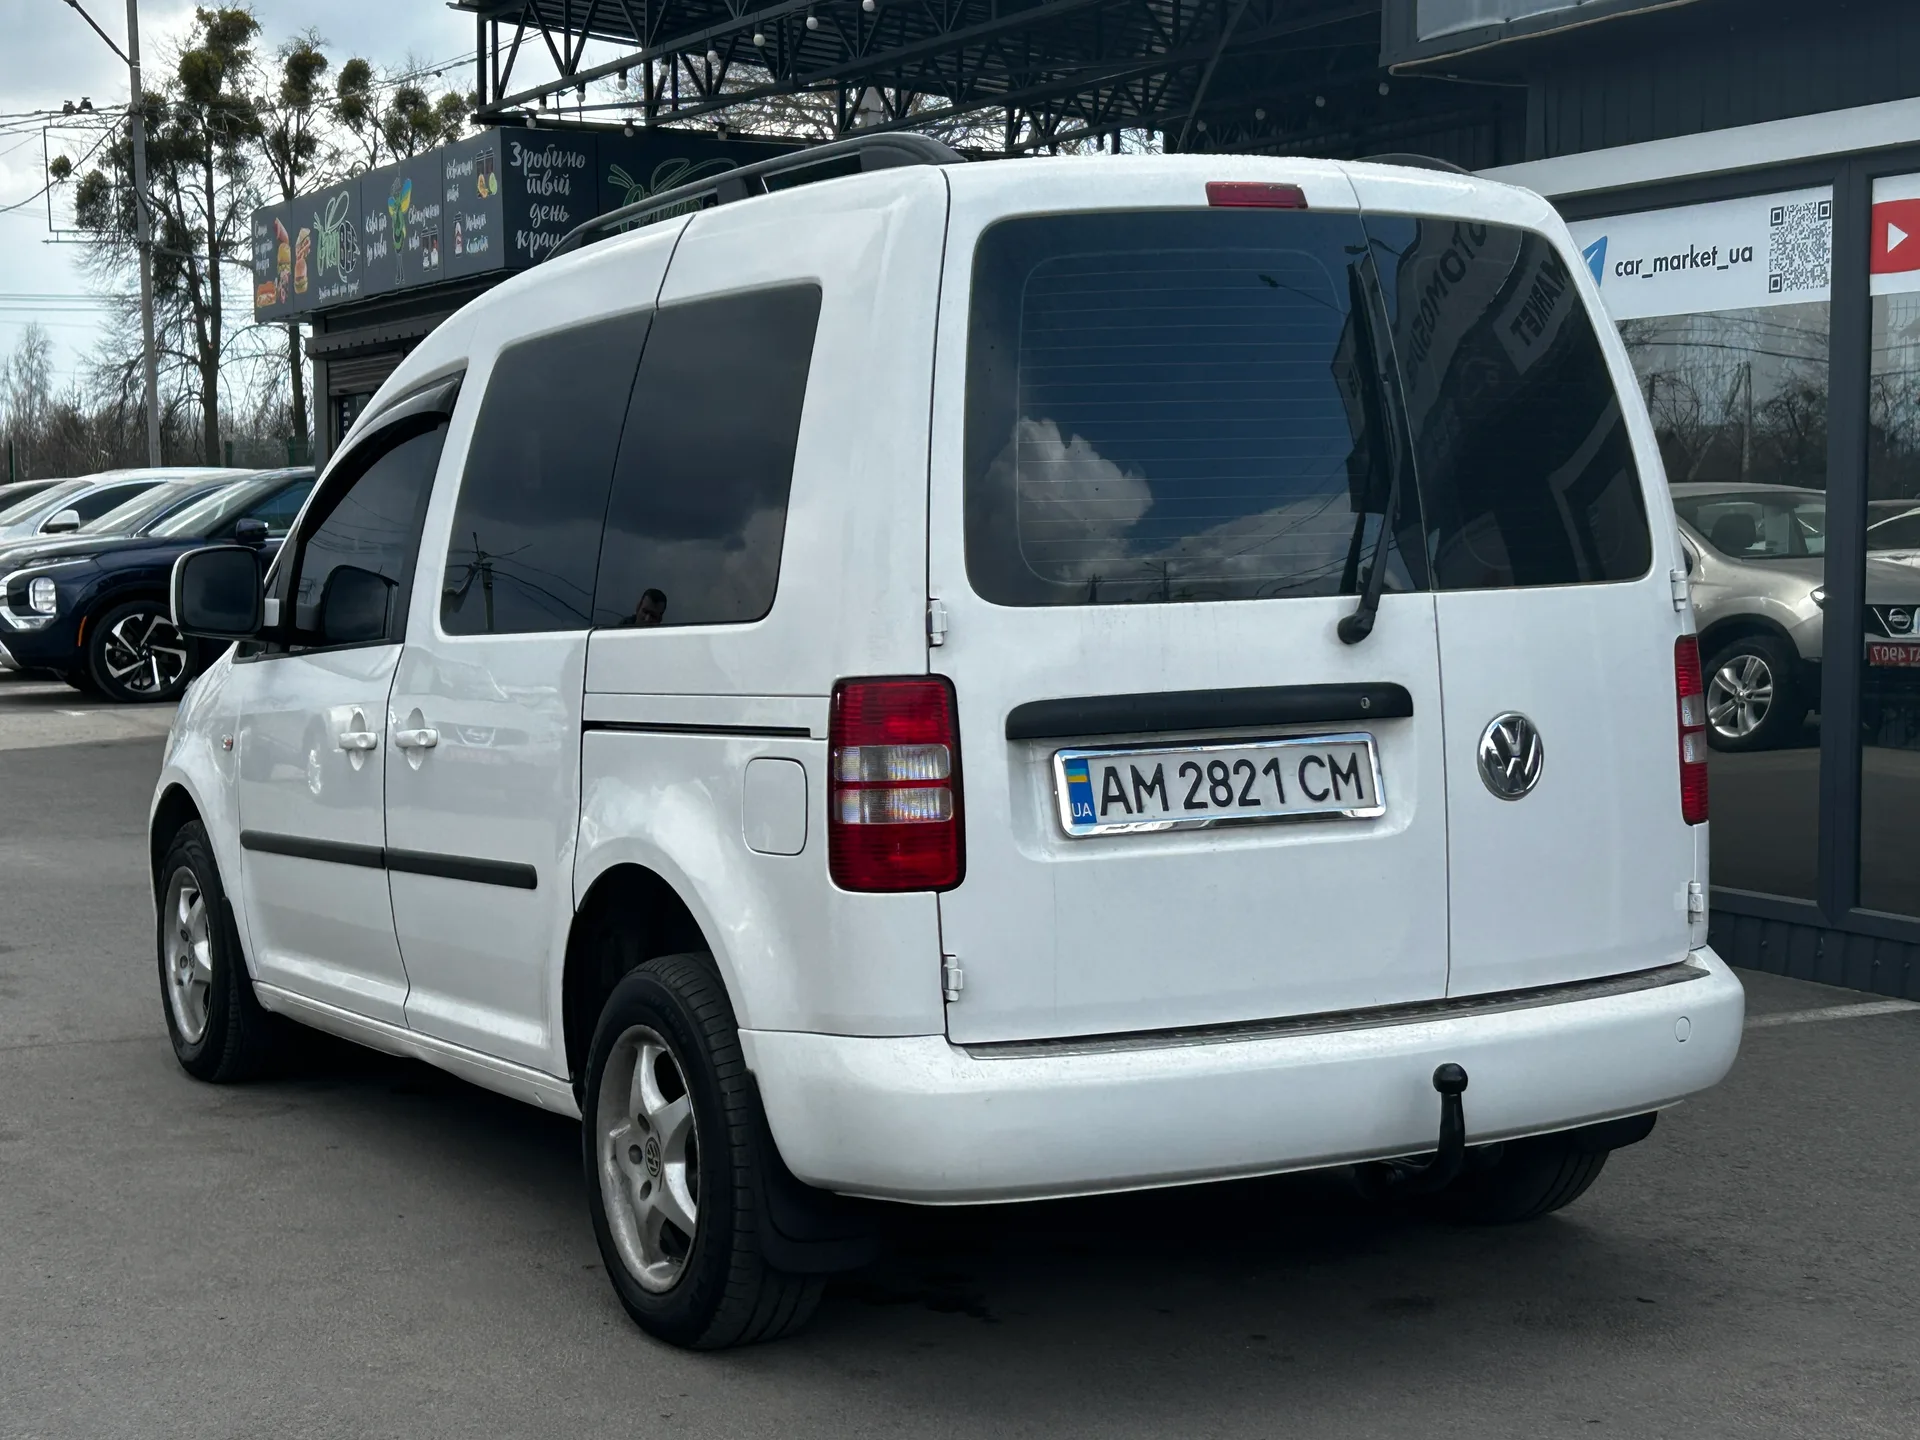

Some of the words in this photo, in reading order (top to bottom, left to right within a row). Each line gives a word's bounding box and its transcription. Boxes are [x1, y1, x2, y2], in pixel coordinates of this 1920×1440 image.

[510, 141, 586, 176] Зробимо
[526, 170, 571, 196] твій
[529, 202, 570, 228] день
[1615, 244, 1753, 279] car_market_ua
[1100, 763, 1169, 816] AM
[1178, 757, 1286, 811] 2821
[1298, 752, 1364, 802] CM
[1072, 802, 1093, 817] UA
